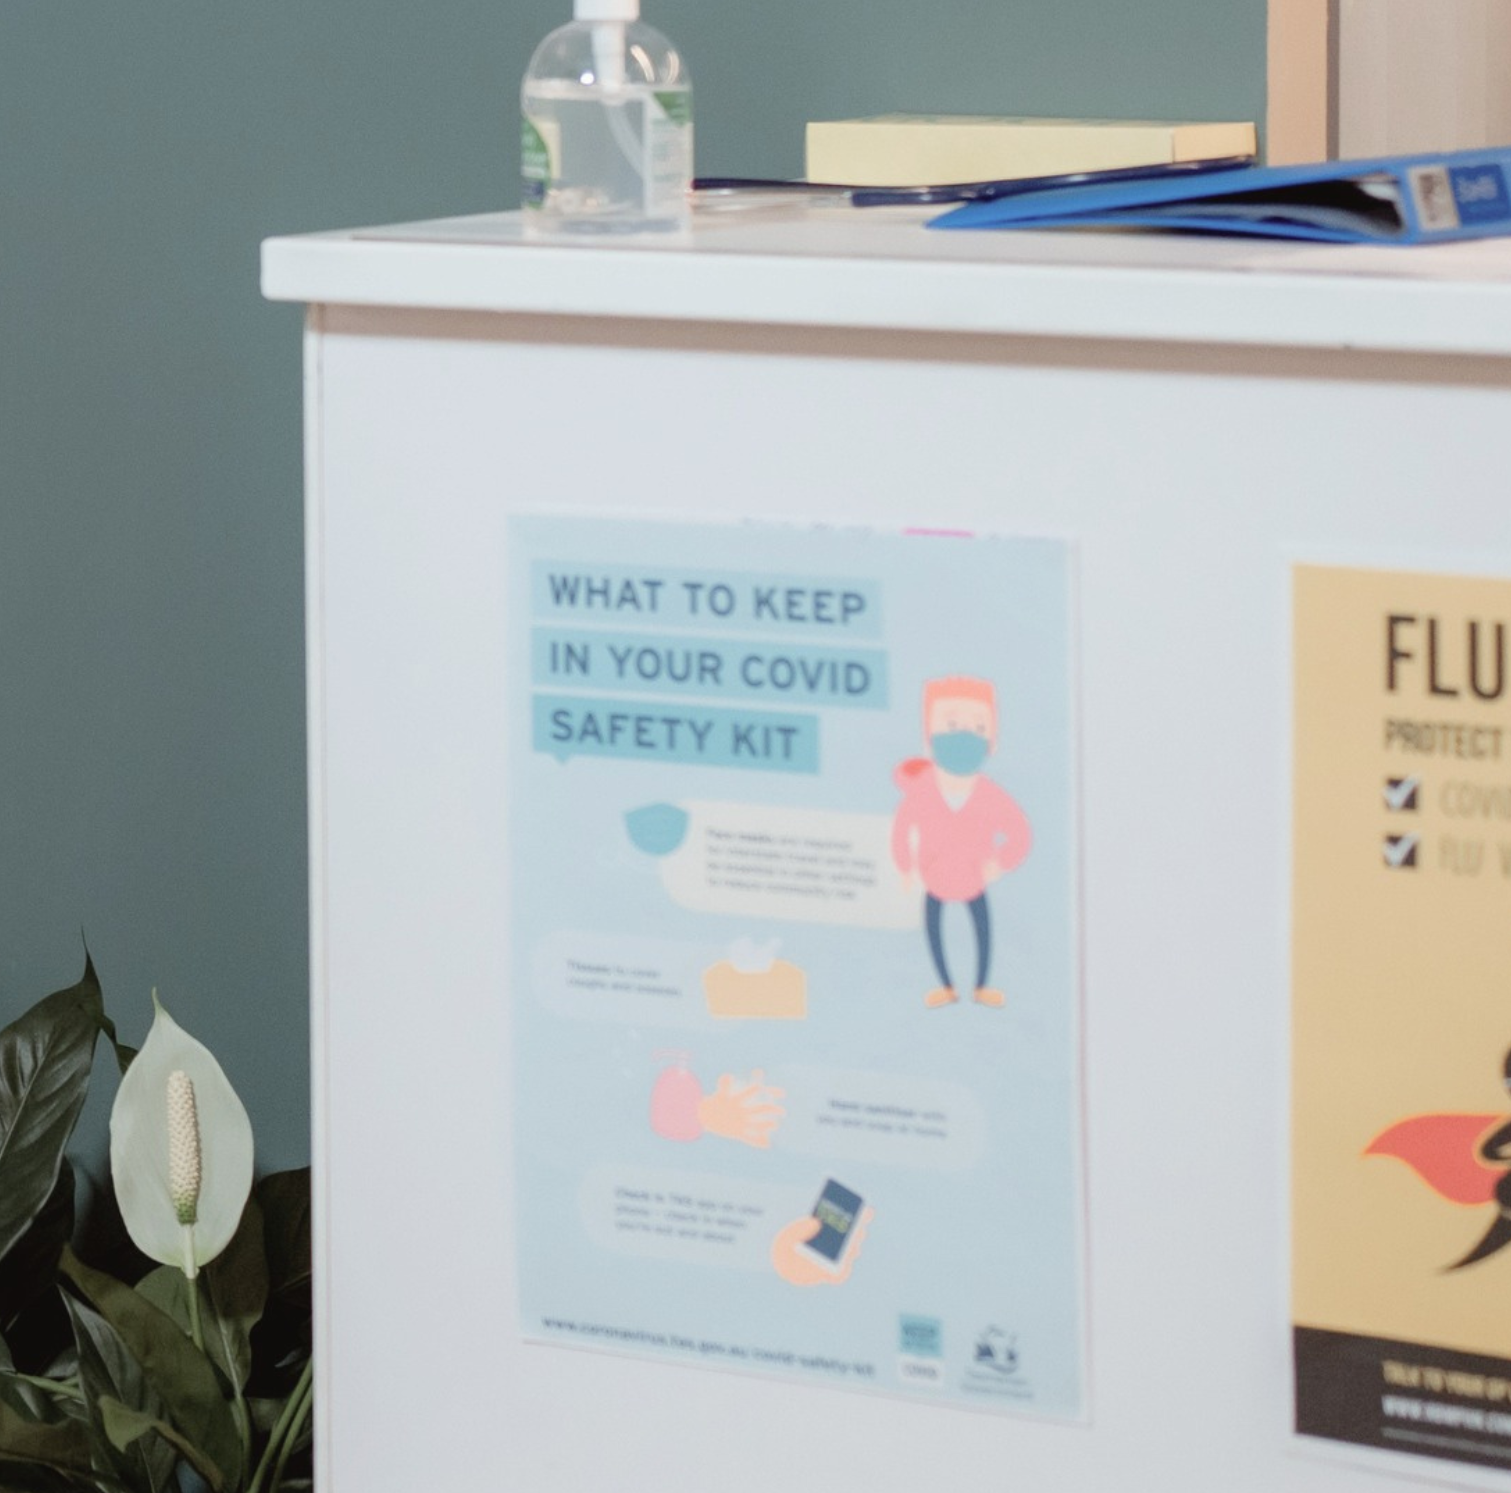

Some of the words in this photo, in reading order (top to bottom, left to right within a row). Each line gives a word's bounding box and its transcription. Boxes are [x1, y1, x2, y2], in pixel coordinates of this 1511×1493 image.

[549, 573, 662, 612] WHAT
[682, 581, 736, 617] TO
[753, 586, 867, 625] KEEP
[550, 642, 589, 676] IN
[608, 646, 722, 685] YOUR
[740, 655, 871, 696] COVID
[1387, 614, 1505, 701] FLU
[551, 709, 712, 754] SAFETY
[732, 724, 799, 761] KIT
[1385, 719, 1502, 760] PROTECT
